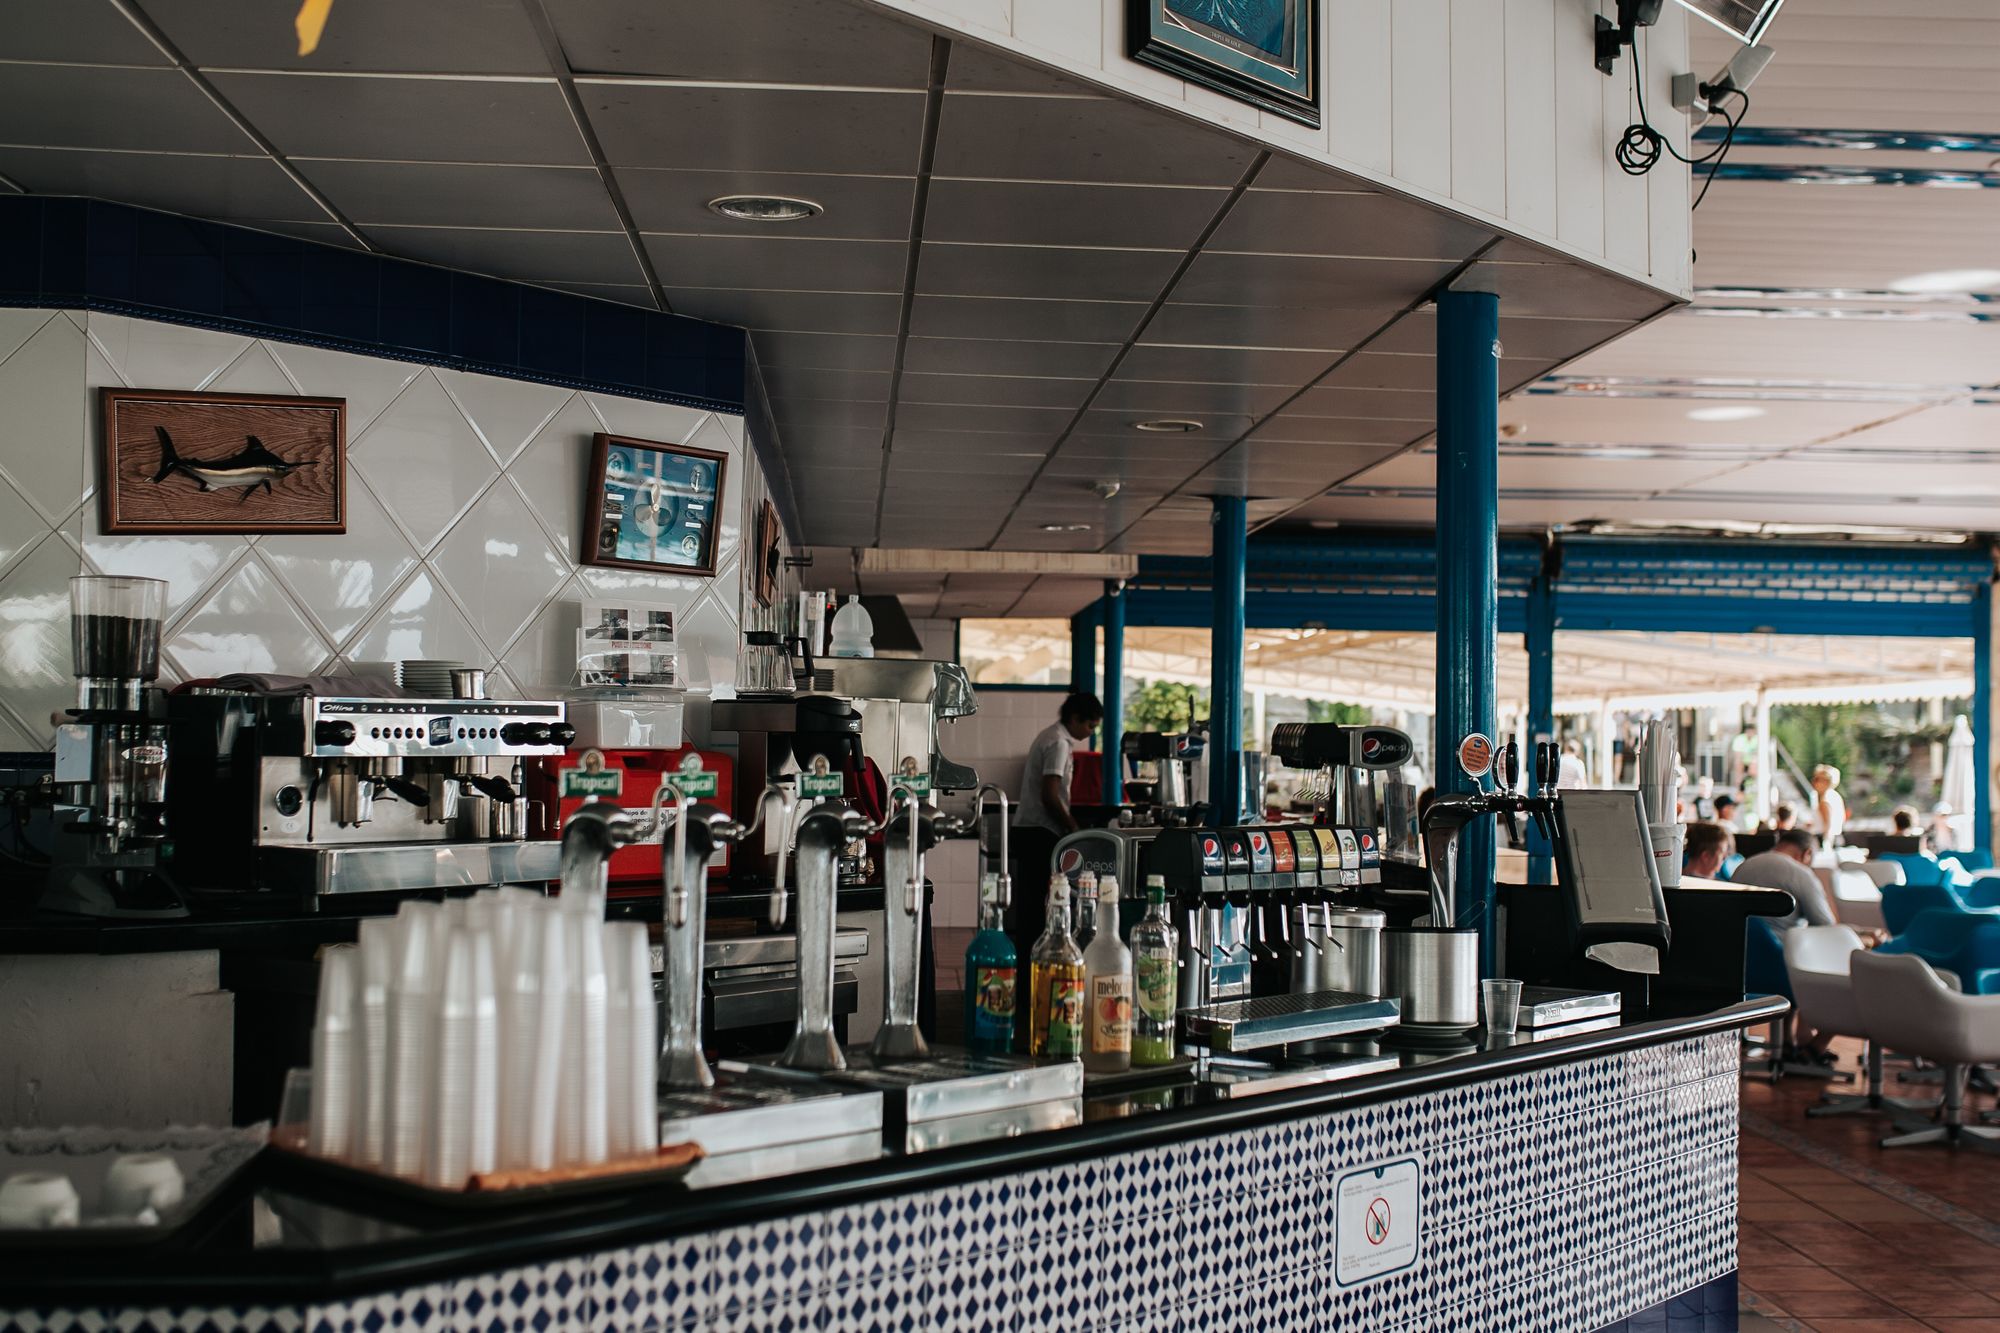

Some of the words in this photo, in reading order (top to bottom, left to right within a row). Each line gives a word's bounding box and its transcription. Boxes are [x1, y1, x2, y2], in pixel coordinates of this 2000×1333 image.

[1381, 744, 1407, 752] pepsi
[569, 773, 617, 792] Tropical
[803, 775, 840, 793] Tropical
[893, 777, 929, 791] Tpical
[1084, 860, 1116, 873] pepsi
